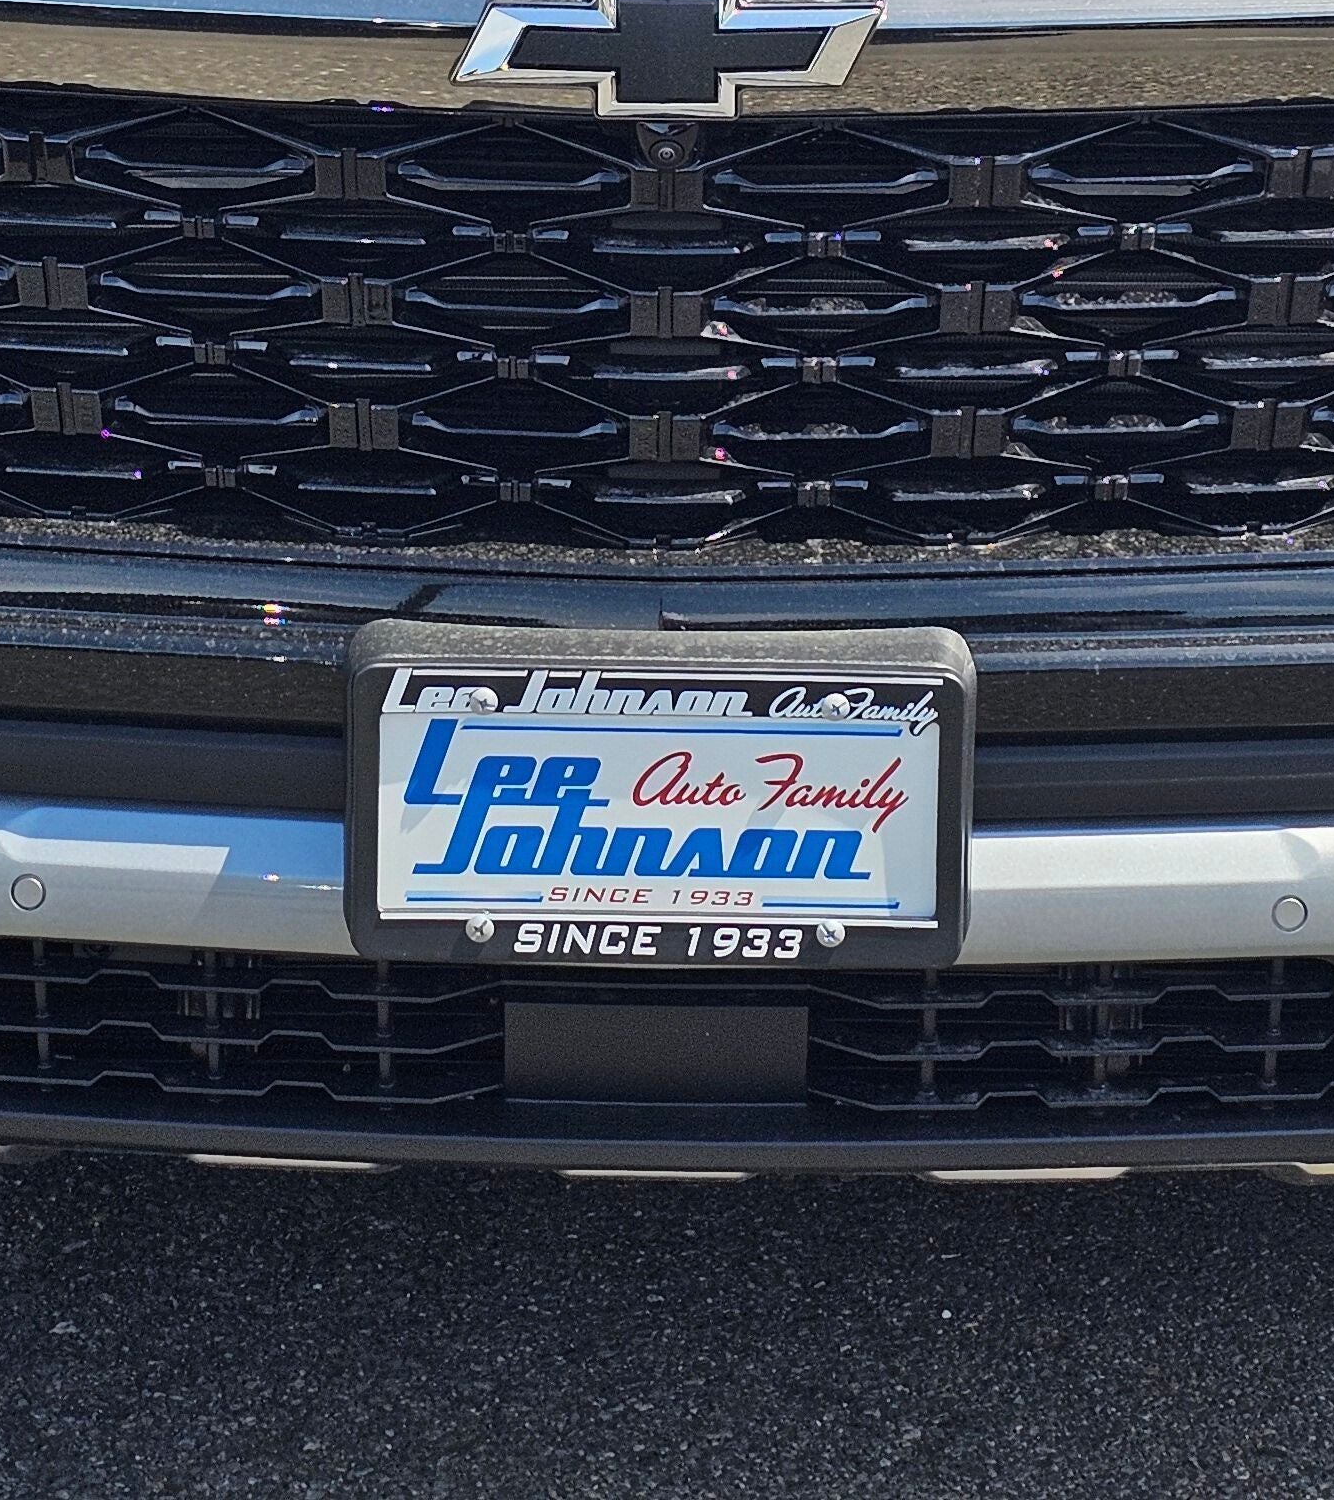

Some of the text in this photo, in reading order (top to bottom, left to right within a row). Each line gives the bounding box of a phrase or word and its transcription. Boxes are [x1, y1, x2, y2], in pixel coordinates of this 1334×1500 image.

[503, 670, 753, 717] Johnson
[768, 686, 830, 719] Aut
[843, 687, 939, 736] Family
[404, 718, 609, 807] Lee
[632, 751, 909, 833] Auto Family
[412, 803, 871, 880] Johnson
[548, 886, 754, 906] SINCE 1933
[513, 922, 804, 960] SINCE 1933
